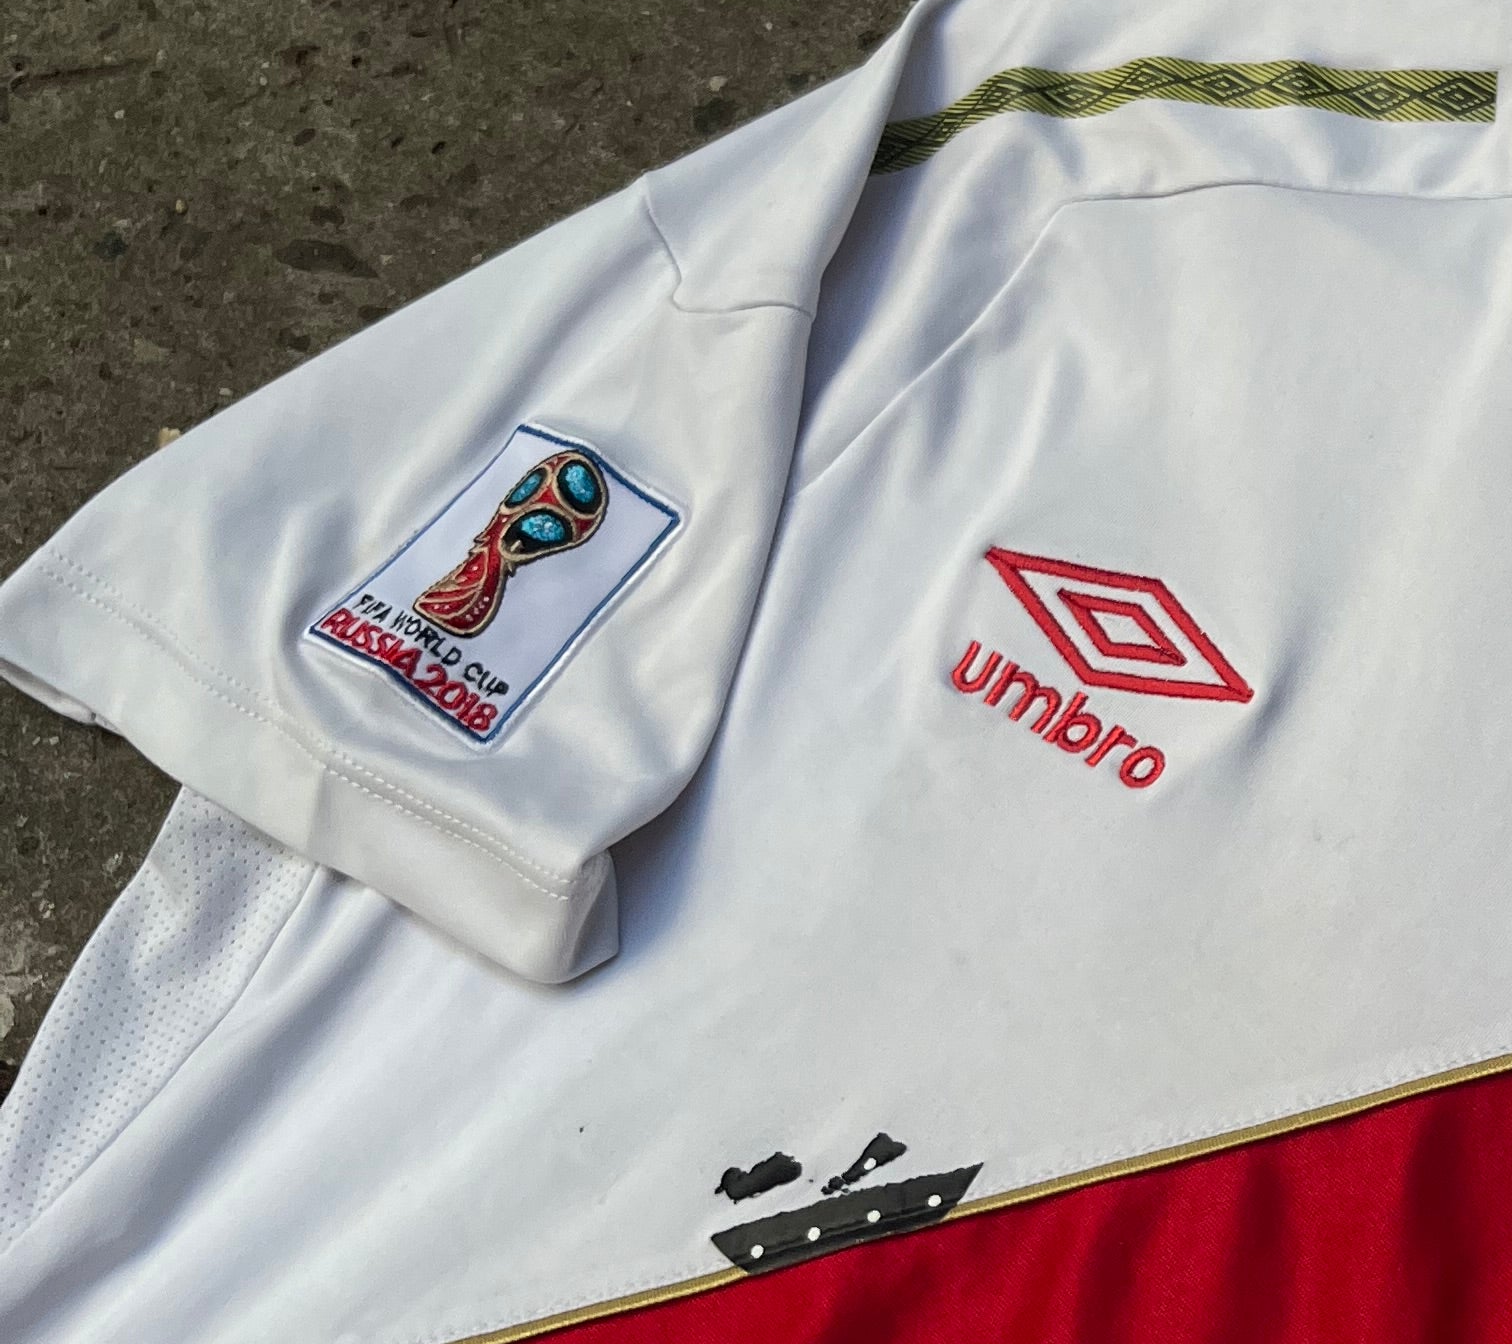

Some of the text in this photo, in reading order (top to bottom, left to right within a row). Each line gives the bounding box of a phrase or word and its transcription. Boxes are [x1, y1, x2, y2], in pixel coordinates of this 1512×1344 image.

[352, 594, 509, 697] FIFA WORLD CUP
[951, 640, 1166, 789] umbro
